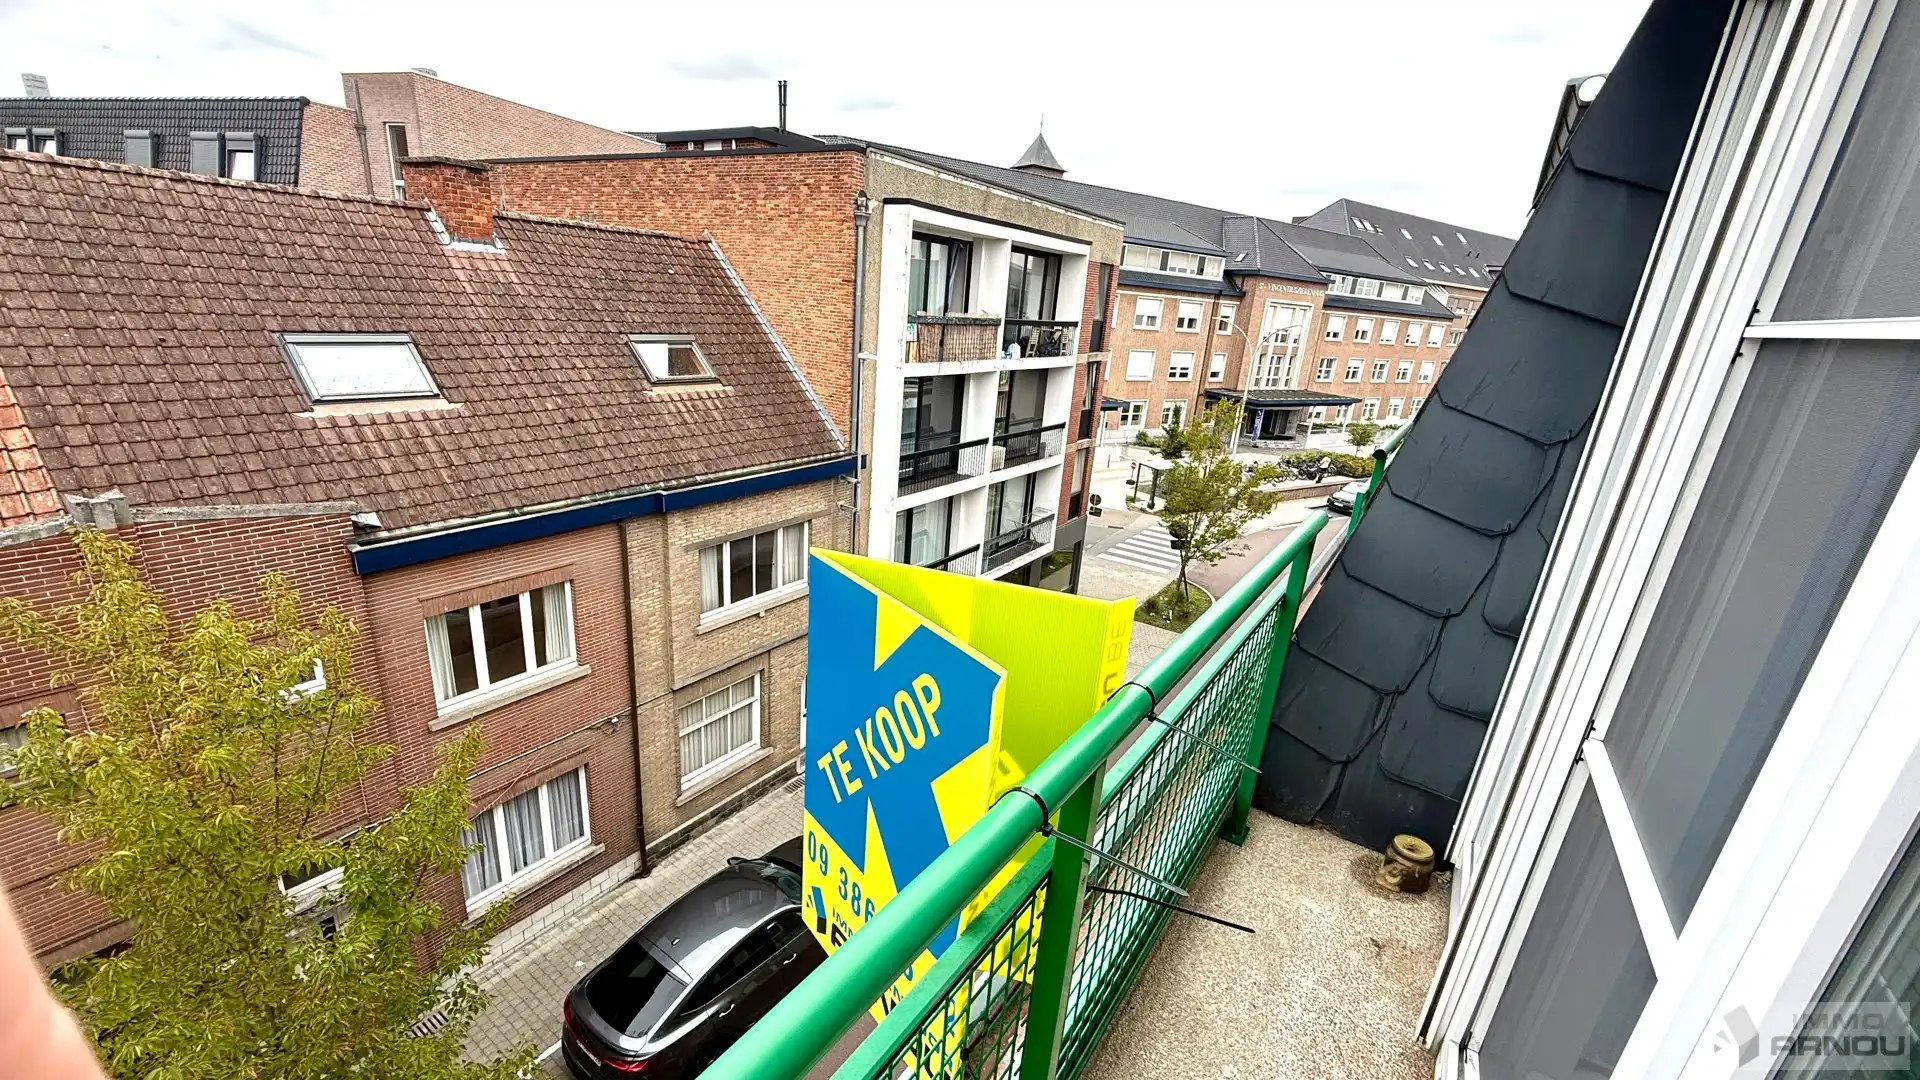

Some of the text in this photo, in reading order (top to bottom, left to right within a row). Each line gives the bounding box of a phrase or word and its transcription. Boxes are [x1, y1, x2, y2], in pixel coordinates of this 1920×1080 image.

[817, 739, 863, 804] TE
[854, 673, 941, 780] KOOP
[808, 830, 829, 876] 09
